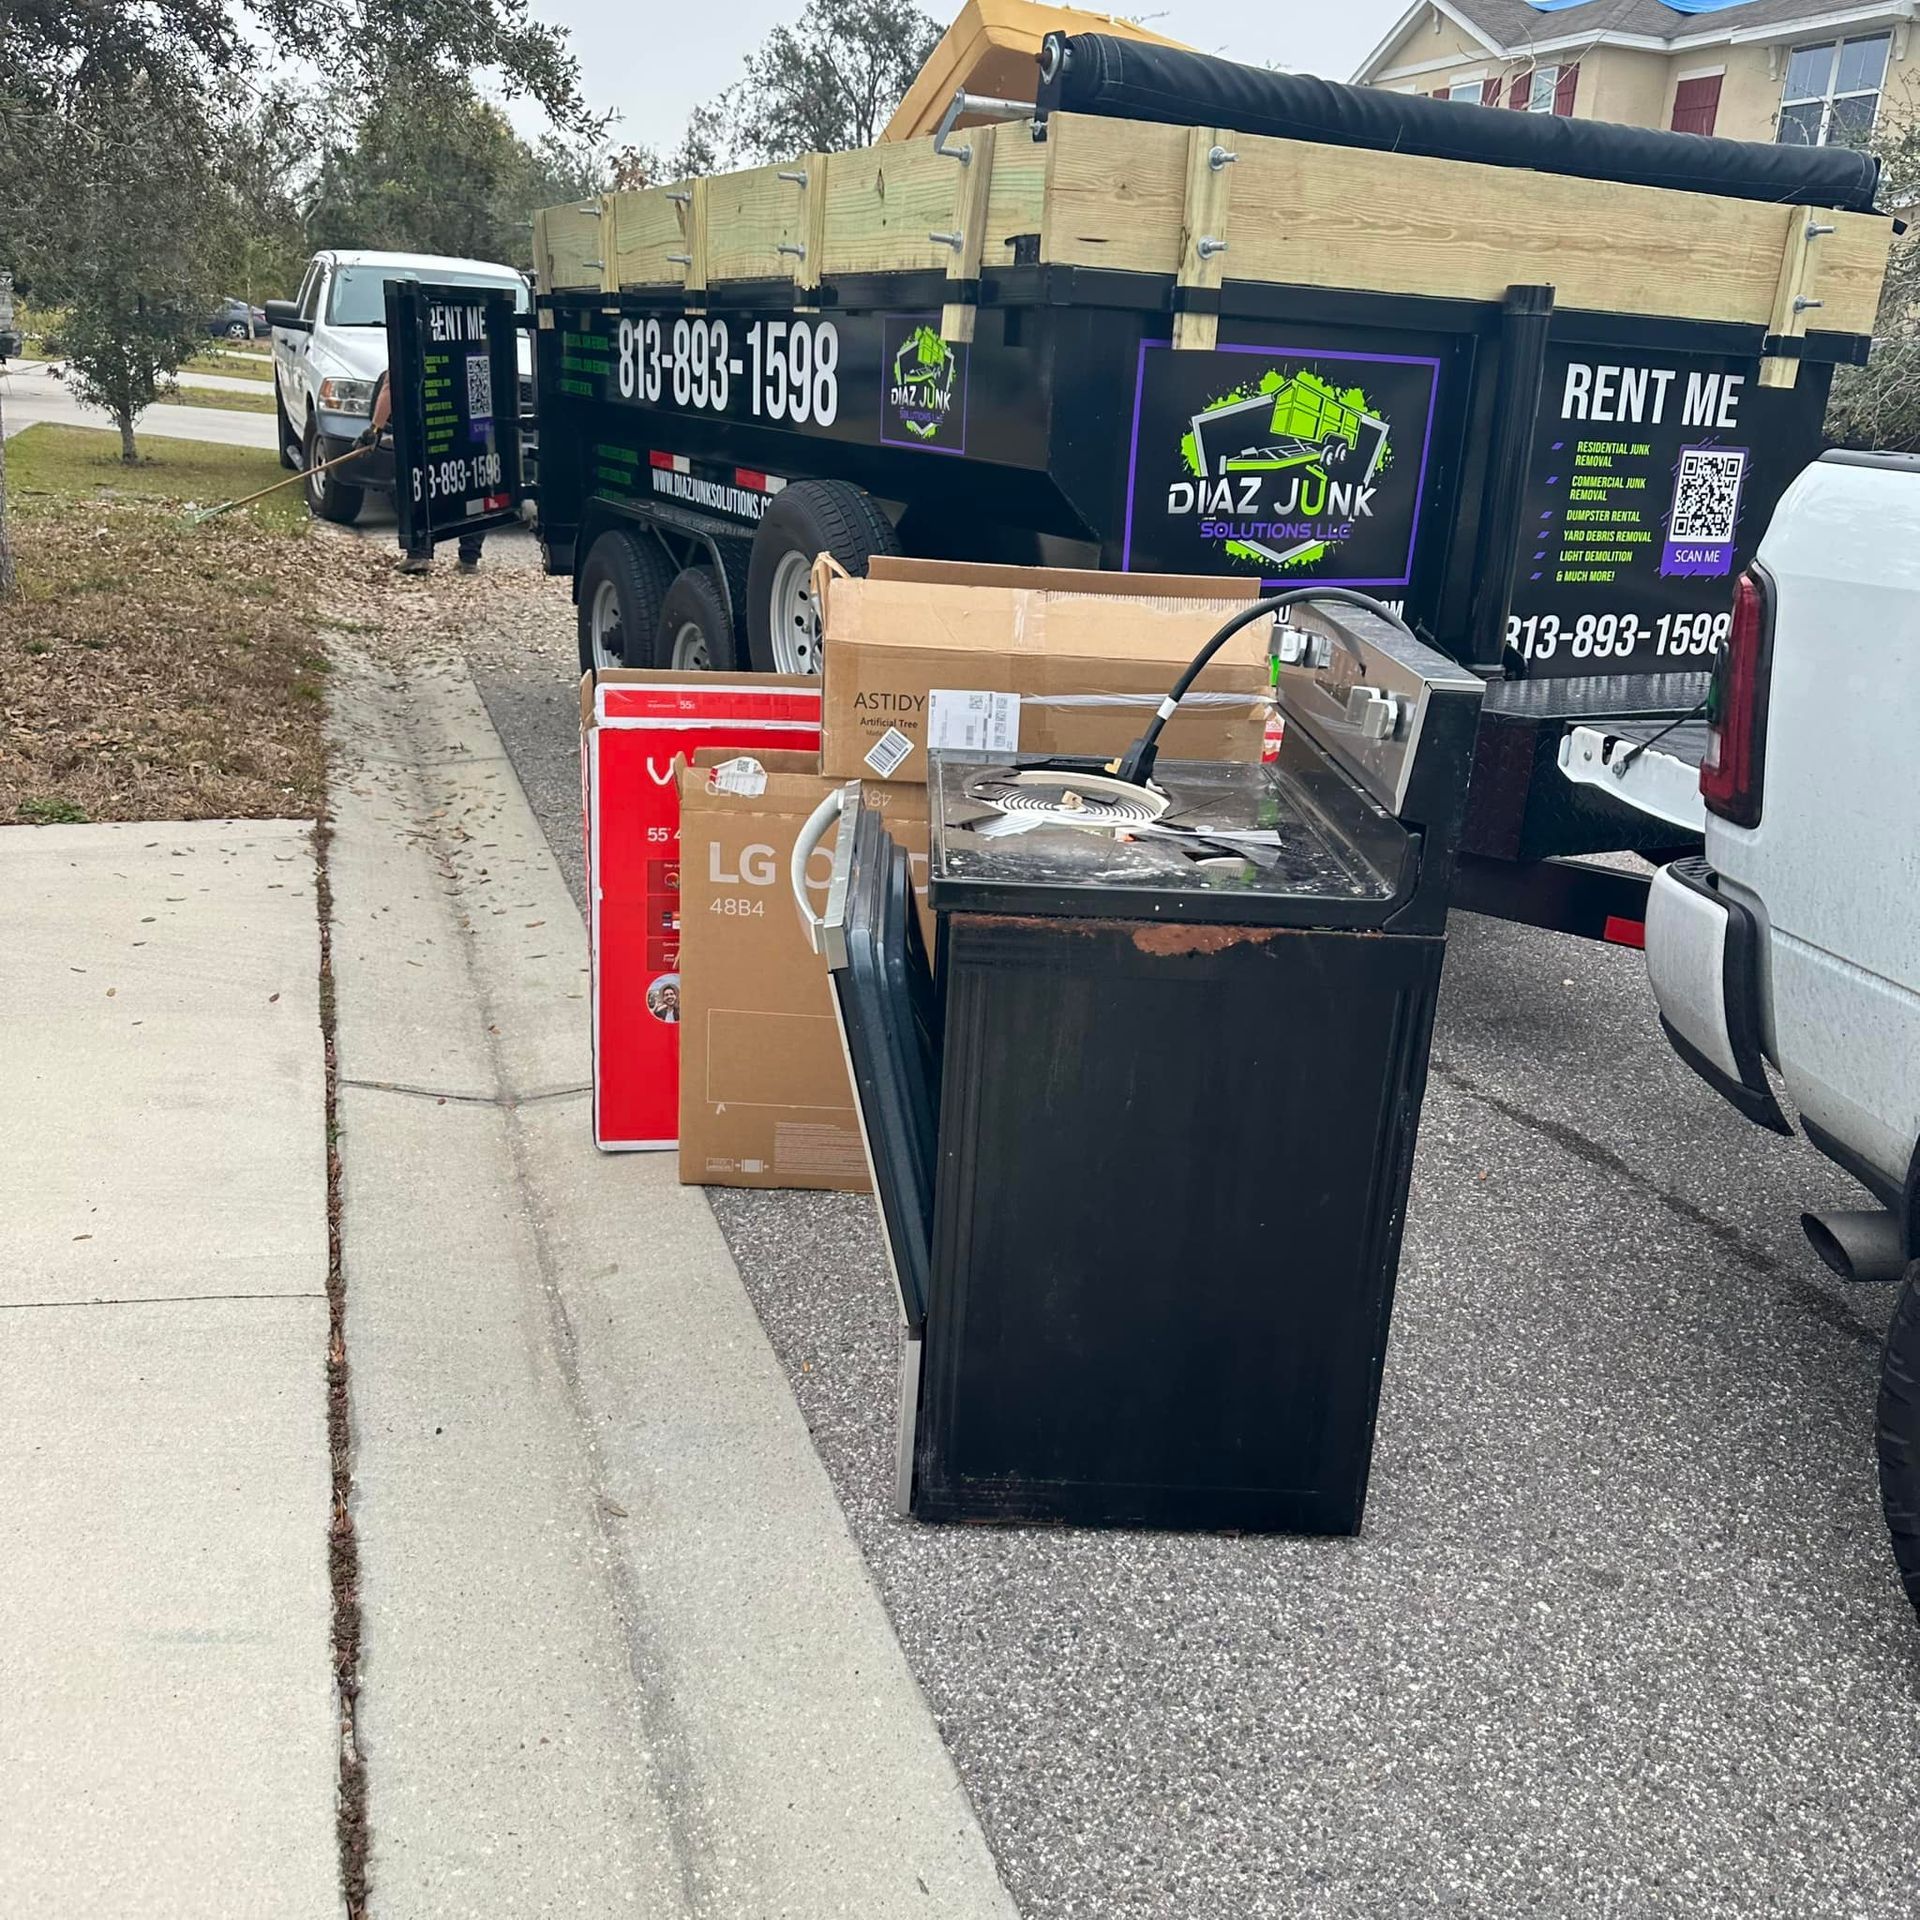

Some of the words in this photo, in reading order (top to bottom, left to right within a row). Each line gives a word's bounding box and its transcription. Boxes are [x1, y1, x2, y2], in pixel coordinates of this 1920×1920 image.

[466, 306, 487, 340] ME
[618, 318, 839, 427] 813-893-1598
[891, 385, 917, 406] DIAZ
[919, 385, 952, 411] JUNK
[1560, 362, 1676, 425] RENT
[1681, 371, 1745, 428] ME
[1577, 441, 1628, 454] RESIDENTIAL
[1629, 443, 1651, 455] JUNK
[1575, 455, 1613, 467] REMOVAL
[1571, 475, 1624, 488] COMMERCIAL
[1625, 477, 1647, 489] JUNK
[1168, 476, 1262, 514] DIAZ
[1273, 474, 1377, 517] JUNK
[1569, 489, 1608, 501] REMOVAL
[1566, 509, 1609, 522] DUMPSTER
[1610, 511, 1641, 522] RENTAL
[1200, 522, 1312, 539] SOLUTIONS
[1316, 523, 1351, 539] LLC
[1563, 530, 1585, 542] YARD
[1586, 530, 1615, 542] DEBRIS
[1615, 531, 1652, 543] REMOVAL
[1559, 551, 1584, 562] LIGHT
[1584, 551, 1633, 562] DEMOLITION
[1674, 549, 1704, 563] SCAN
[1704, 550, 1721, 563] ME
[1556, 571, 1563, 582] &
[1564, 571, 1588, 582] MUCH
[1588, 571, 1616, 582] MORE!
[854, 692, 926, 712] ASTIDY
[860, 717, 897, 729] Artificial
[899, 719, 919, 729] Tree
[709, 841, 777, 886] LG
[709, 898, 765, 918] 48B4
